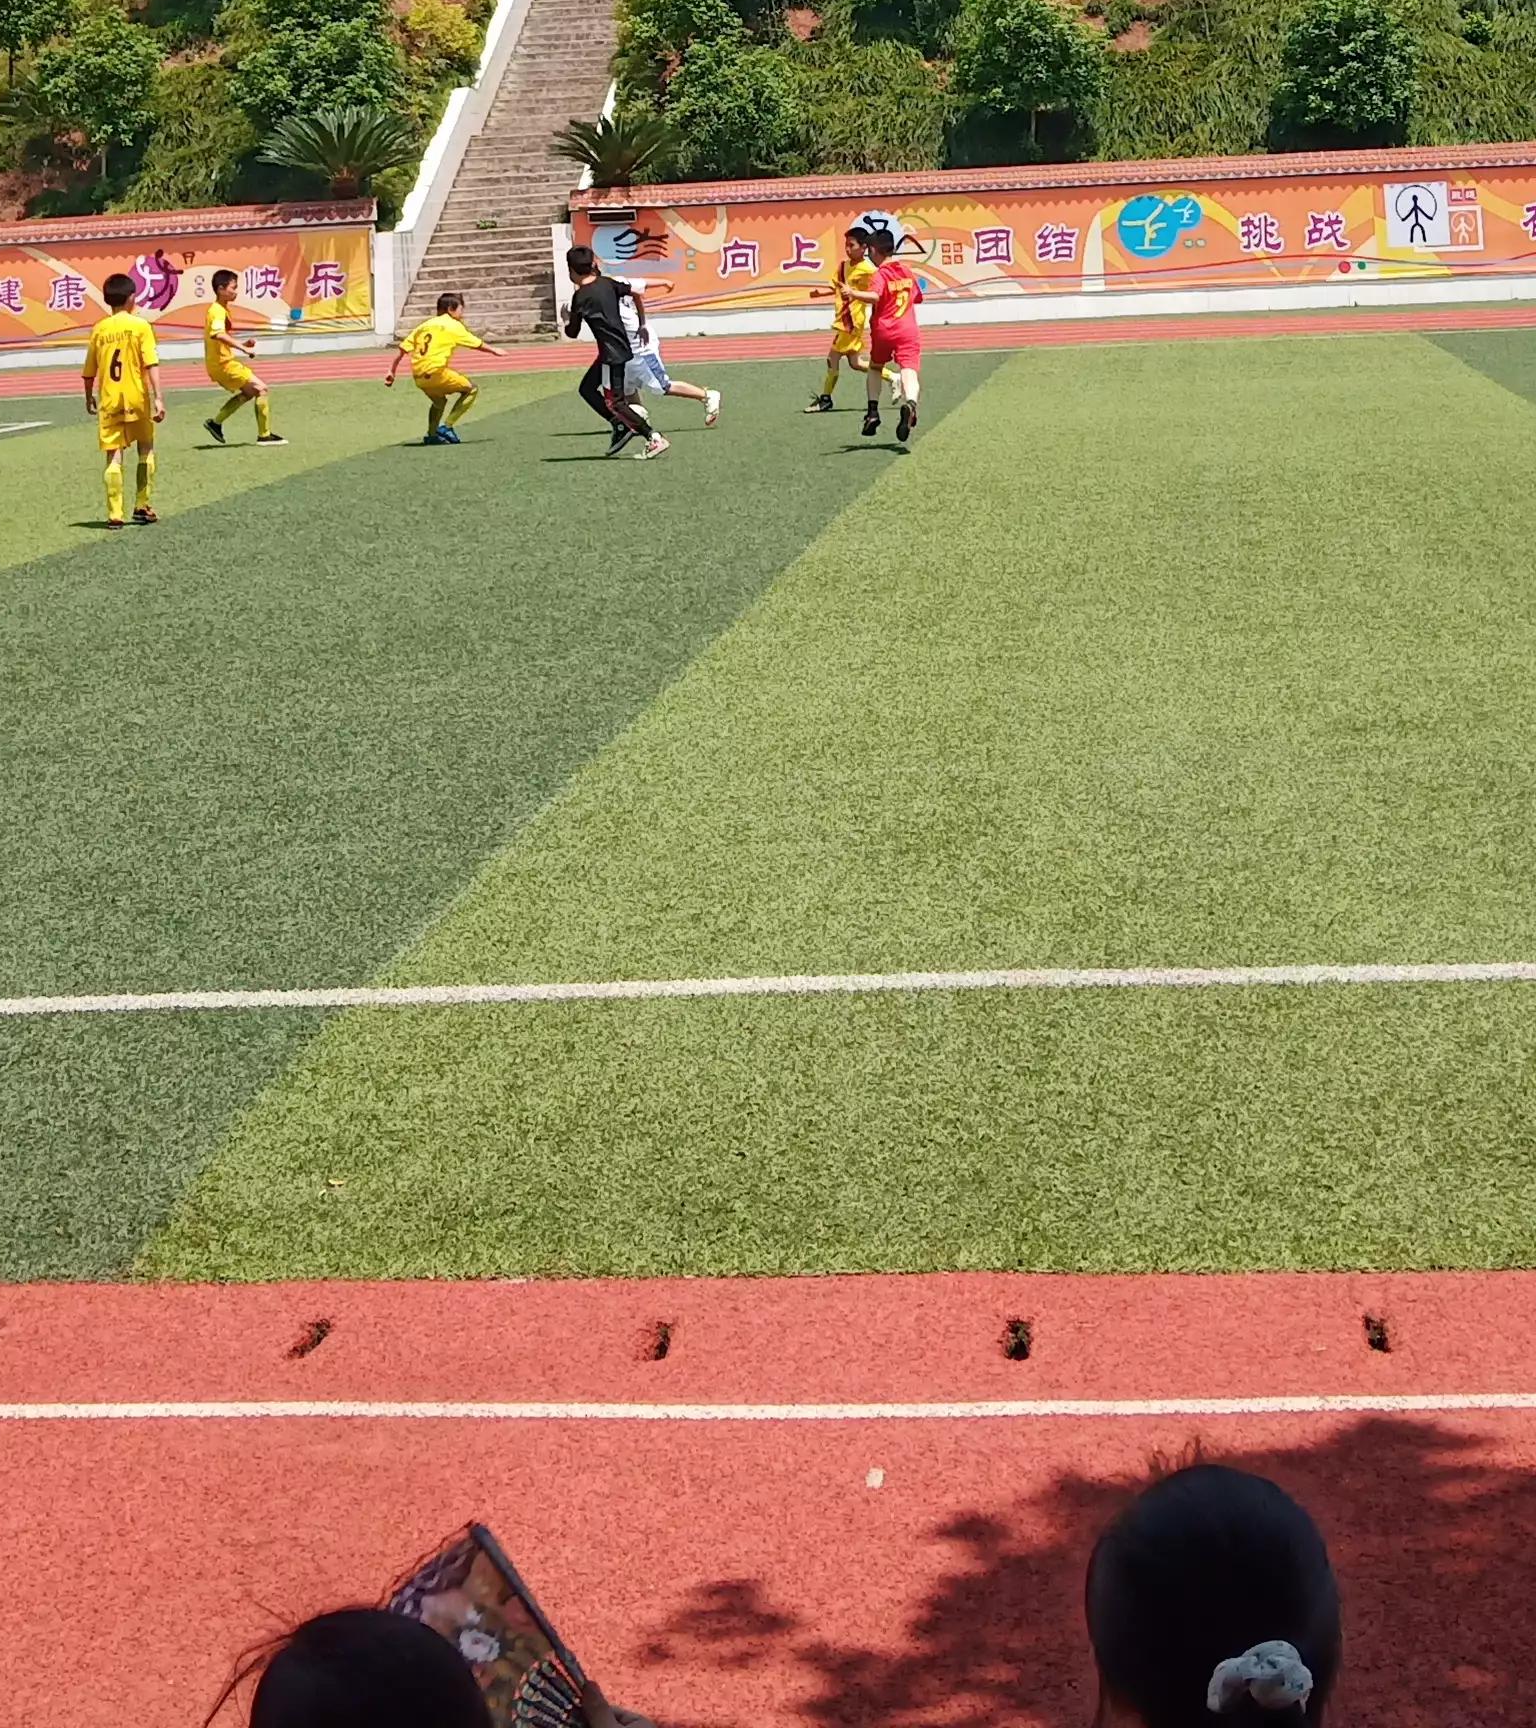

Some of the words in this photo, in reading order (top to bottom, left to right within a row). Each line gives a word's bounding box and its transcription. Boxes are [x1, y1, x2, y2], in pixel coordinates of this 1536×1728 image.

[975, 224, 1078, 264] 团结
[1240, 210, 1350, 252] 挑战
[720, 235, 824, 277] 向上
[244, 260, 345, 300] 快乐
[419, 333, 432, 356] 3
[110, 349, 123, 382] 6
